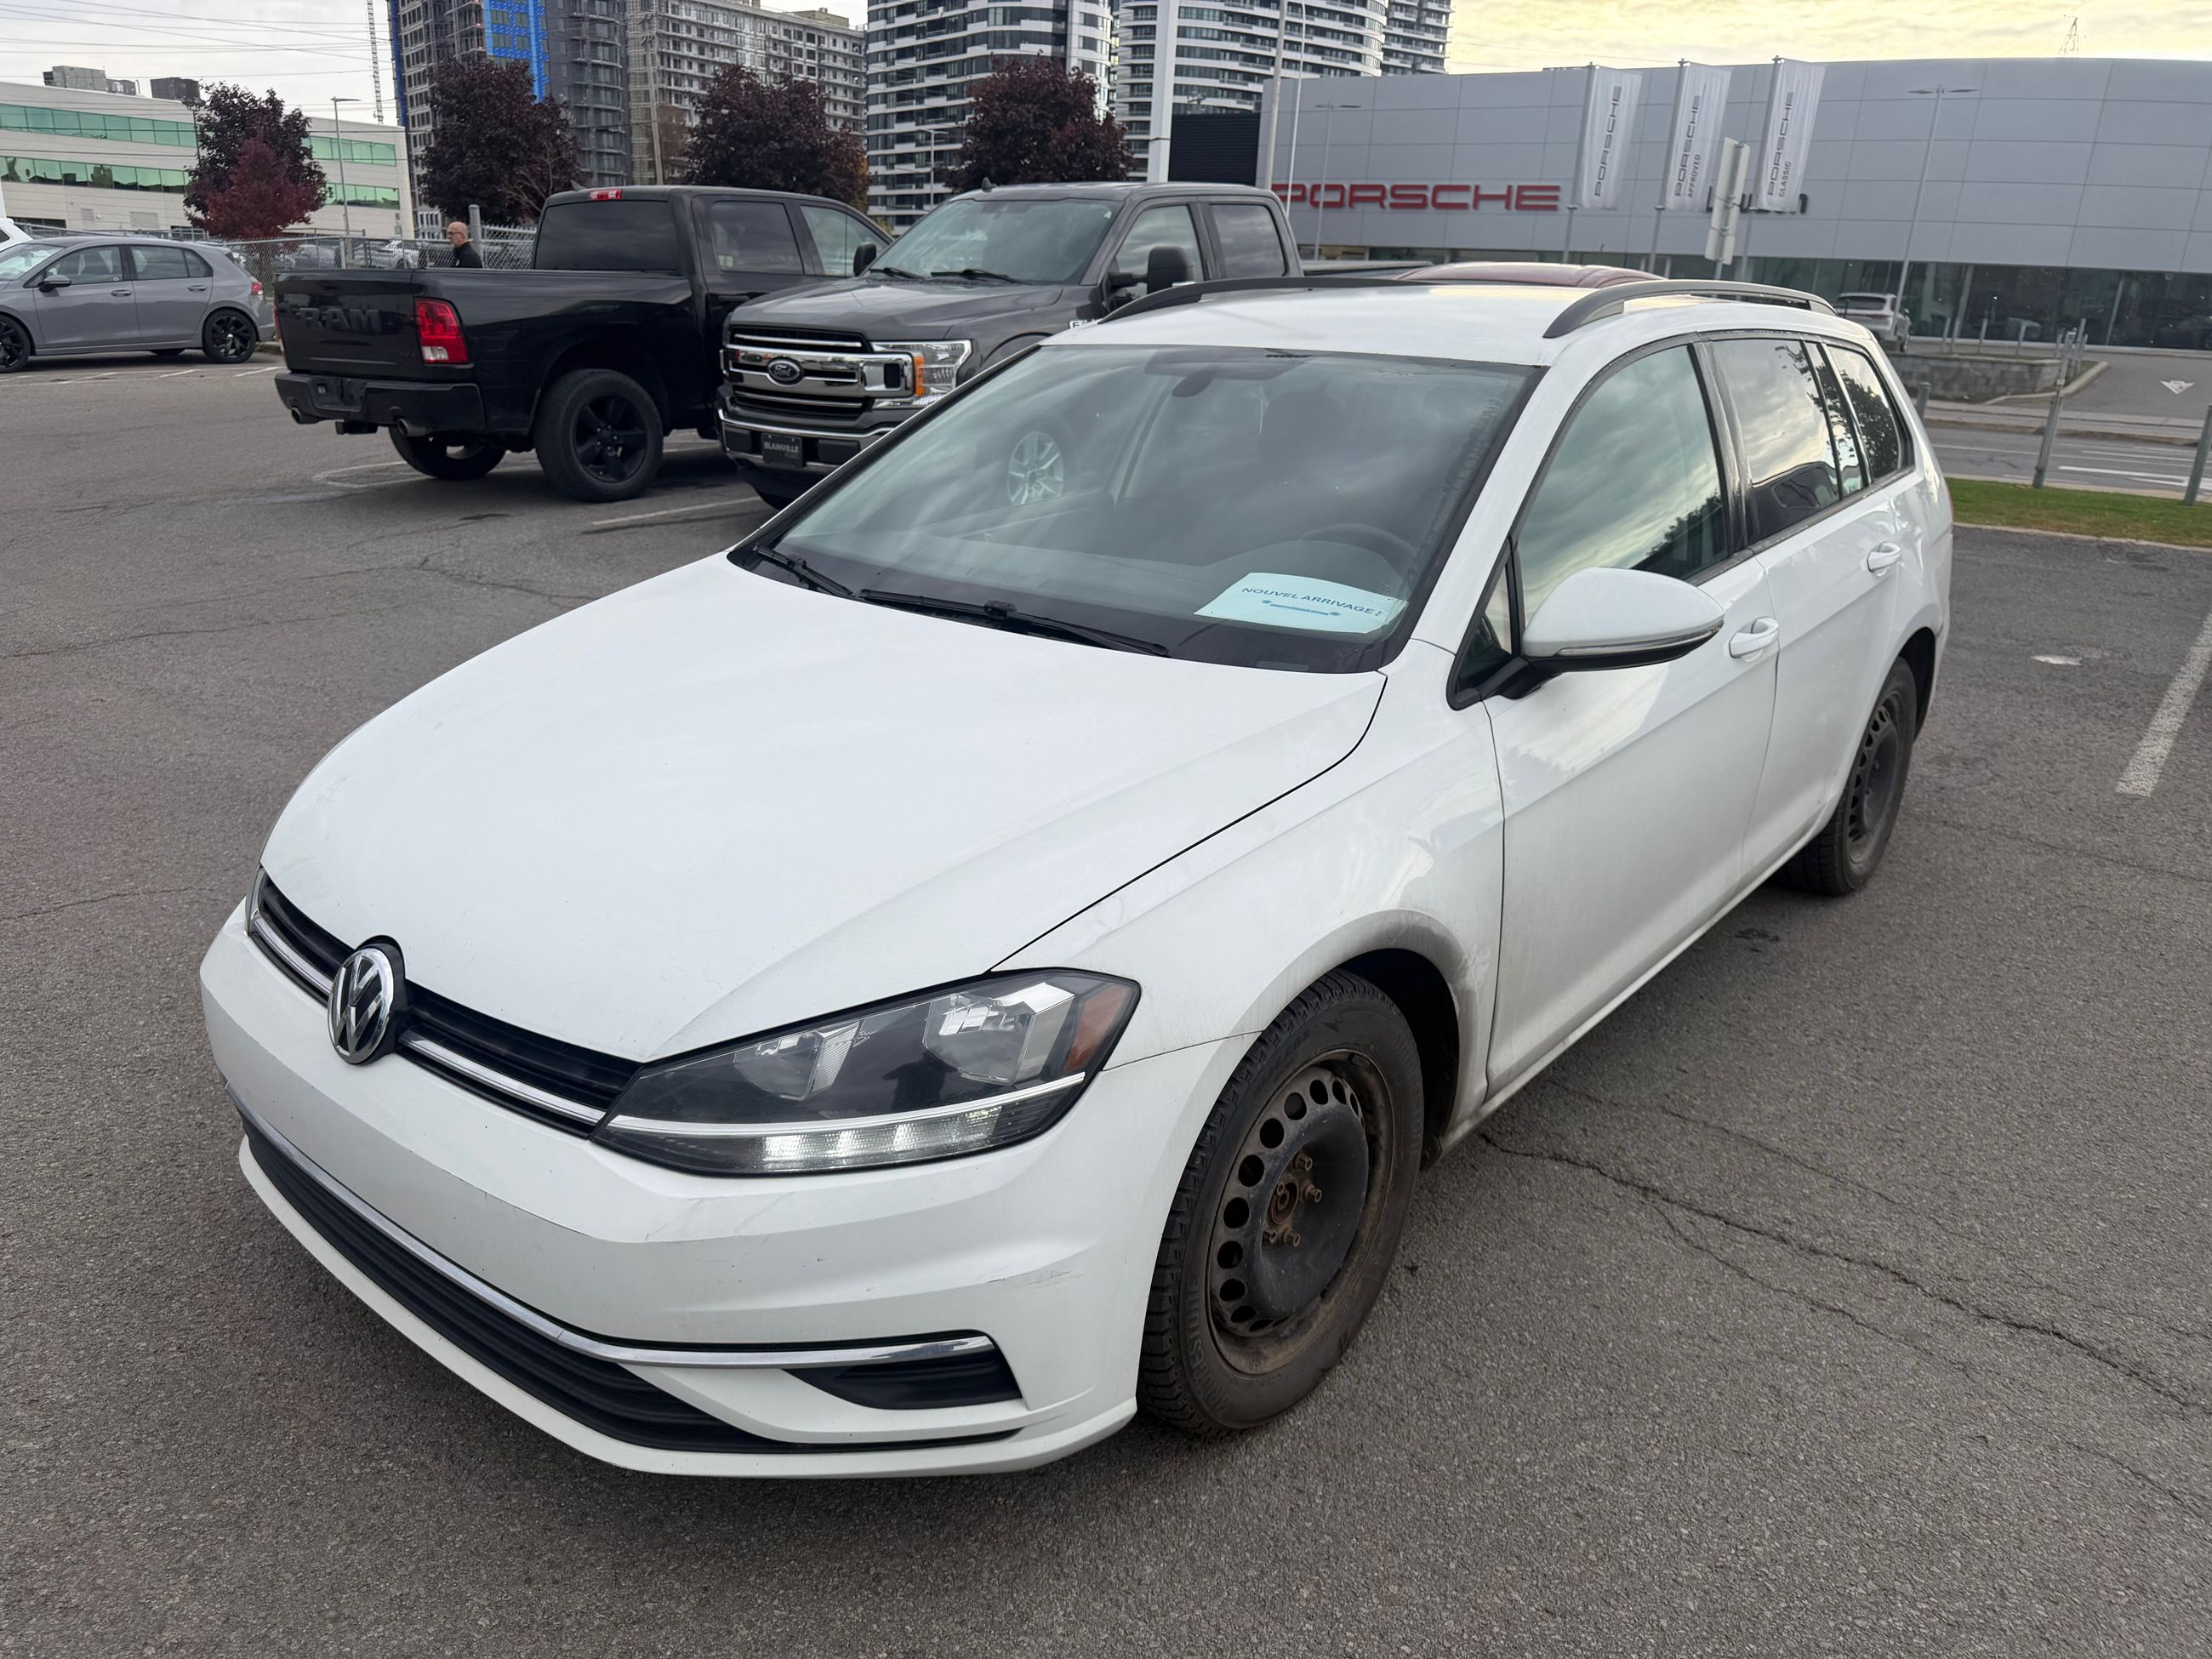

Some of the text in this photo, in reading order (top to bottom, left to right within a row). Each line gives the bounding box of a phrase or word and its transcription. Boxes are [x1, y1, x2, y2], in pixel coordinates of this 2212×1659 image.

[1594, 85, 1622, 197] PORSCHE
[1674, 94, 1702, 197] PORSCHE
[1768, 91, 1794, 196] PORSCHE
[1687, 153, 1702, 198] APPROVED
[1779, 161, 1792, 197] CLASSIC
[1271, 183, 1561, 210] PORSCHE
[299, 307, 383, 334] RAM
[1241, 587, 1298, 599] NOUVEL
[1300, 595, 1375, 614] ARRIVAGE
